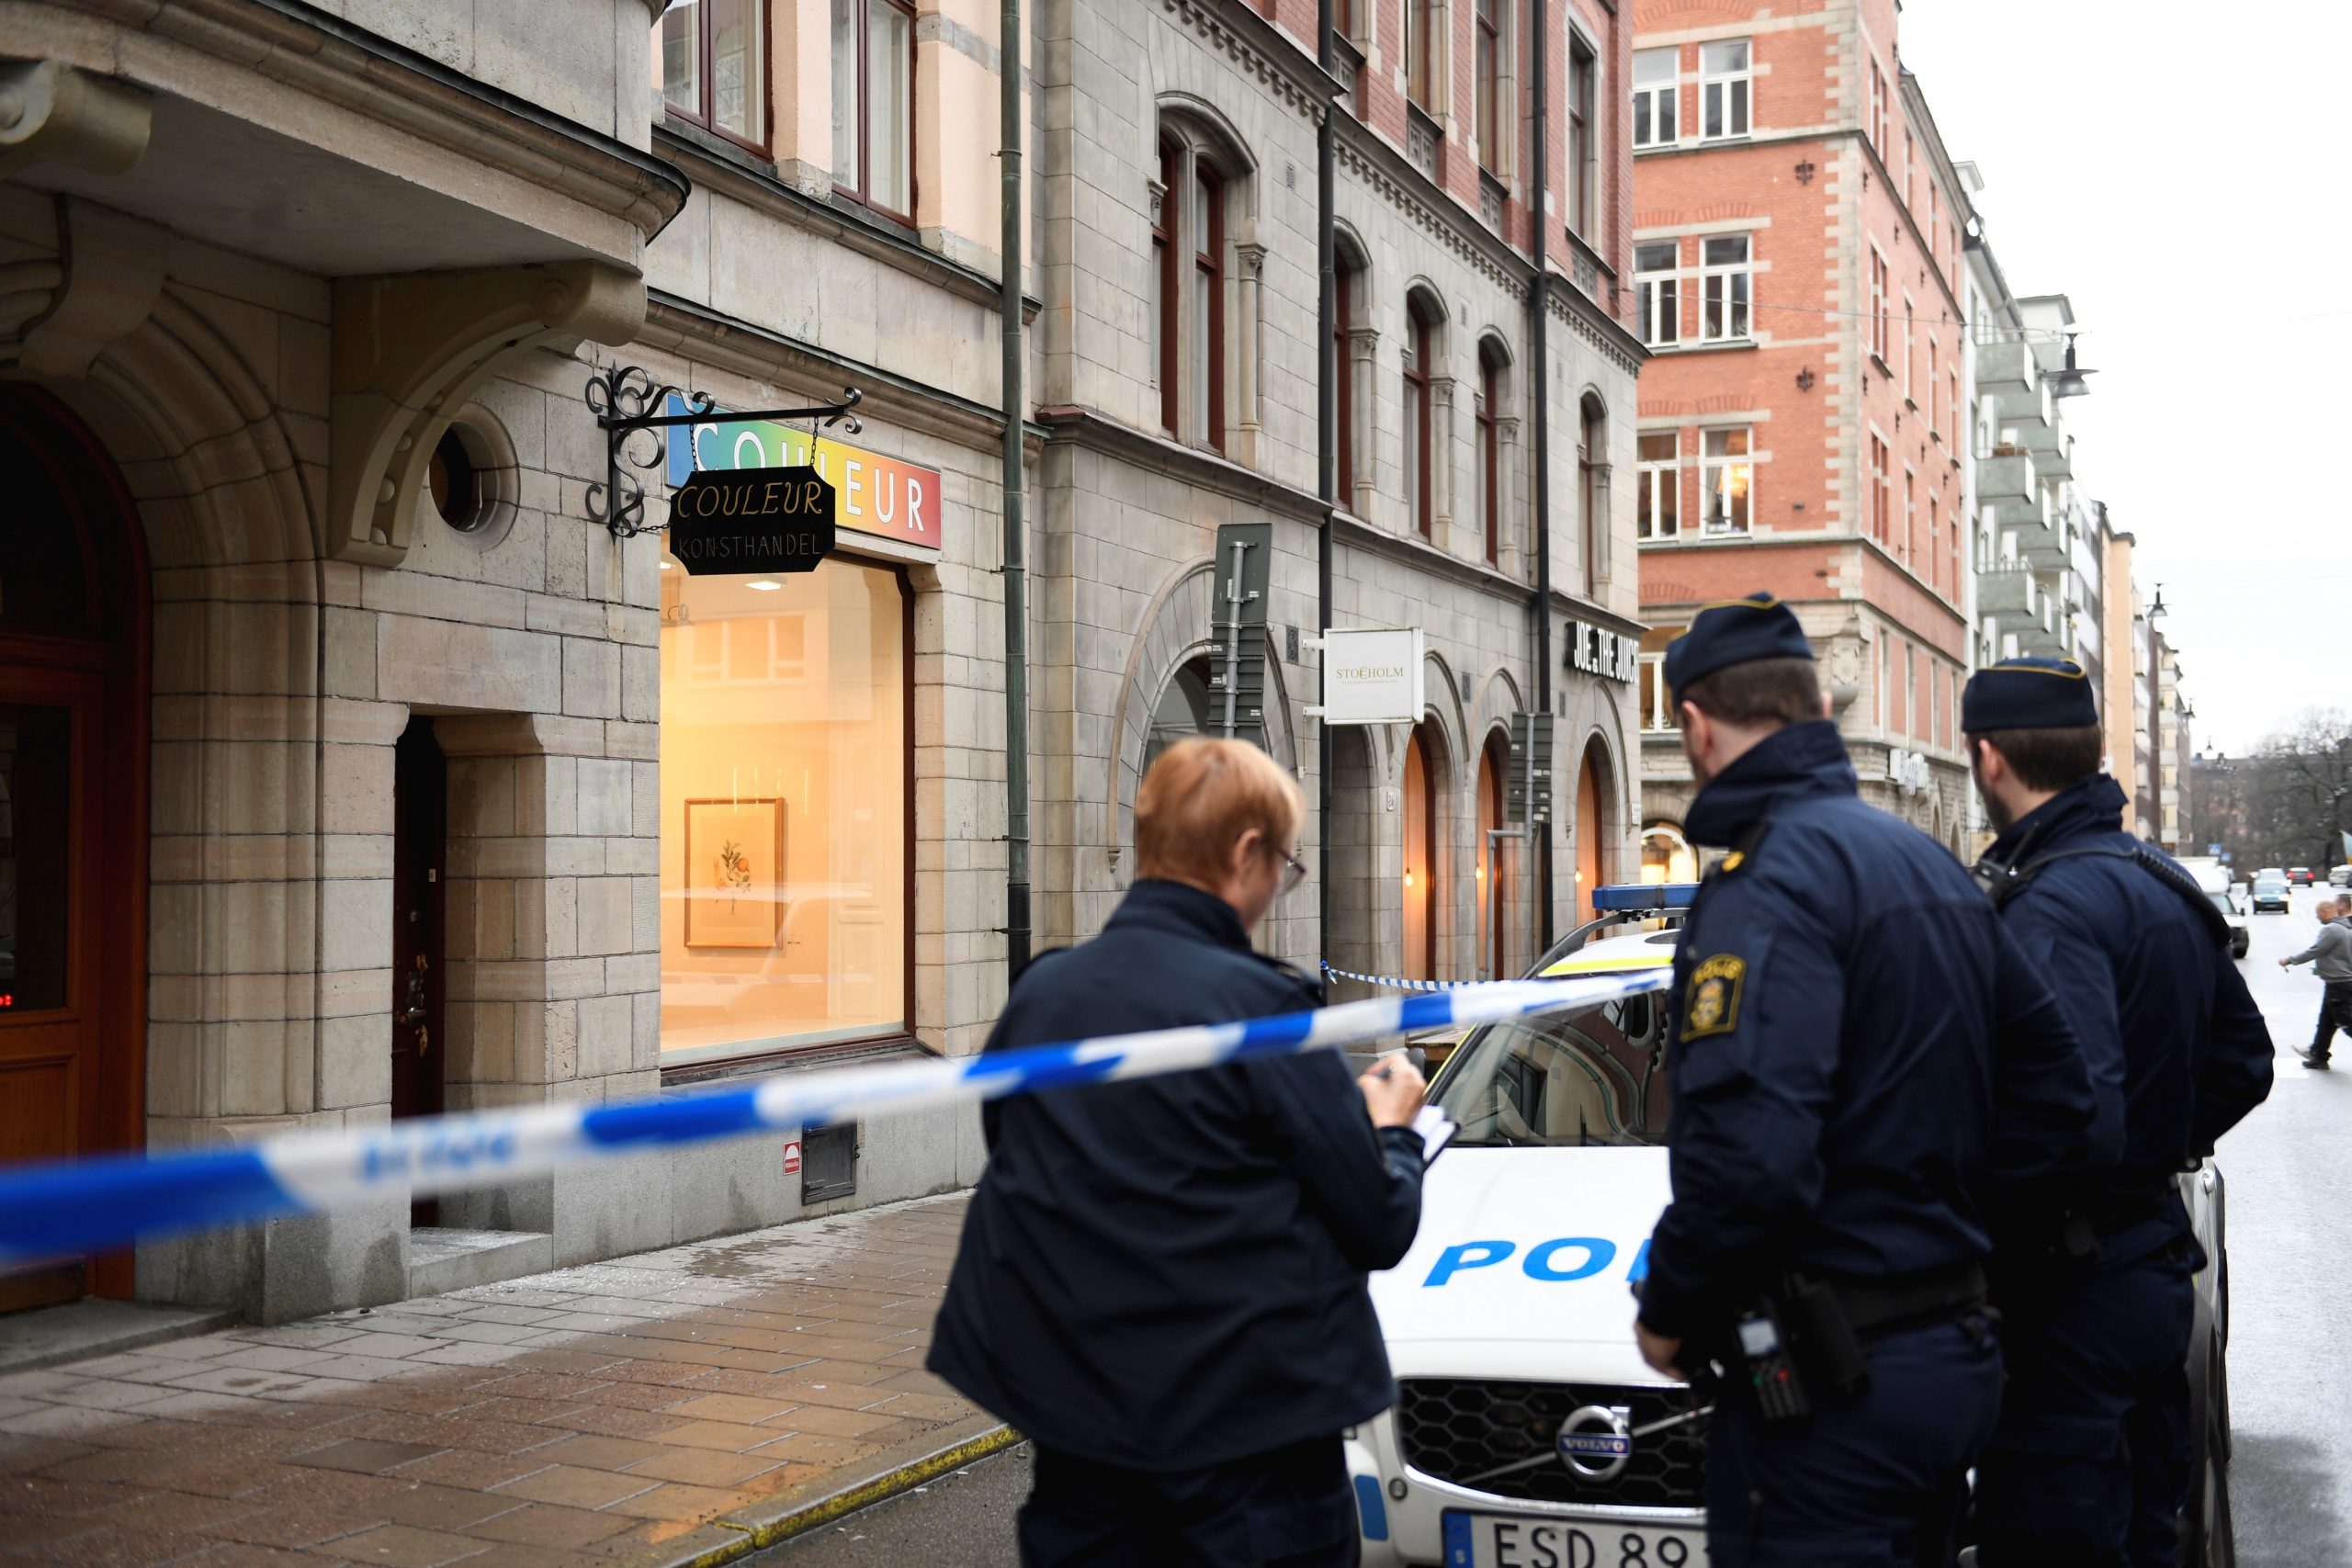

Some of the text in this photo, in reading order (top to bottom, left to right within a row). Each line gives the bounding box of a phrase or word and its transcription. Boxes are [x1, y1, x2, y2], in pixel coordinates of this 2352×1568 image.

[677, 480, 823, 518] COULEUR
[678, 533, 821, 559] KONSTHANDEL
[1574, 620, 1591, 671] JOE
[1597, 627, 1614, 678] THE
[1564, 1438, 1625, 1453] VOLVO
[1493, 1523, 1709, 1568] ESD 89
